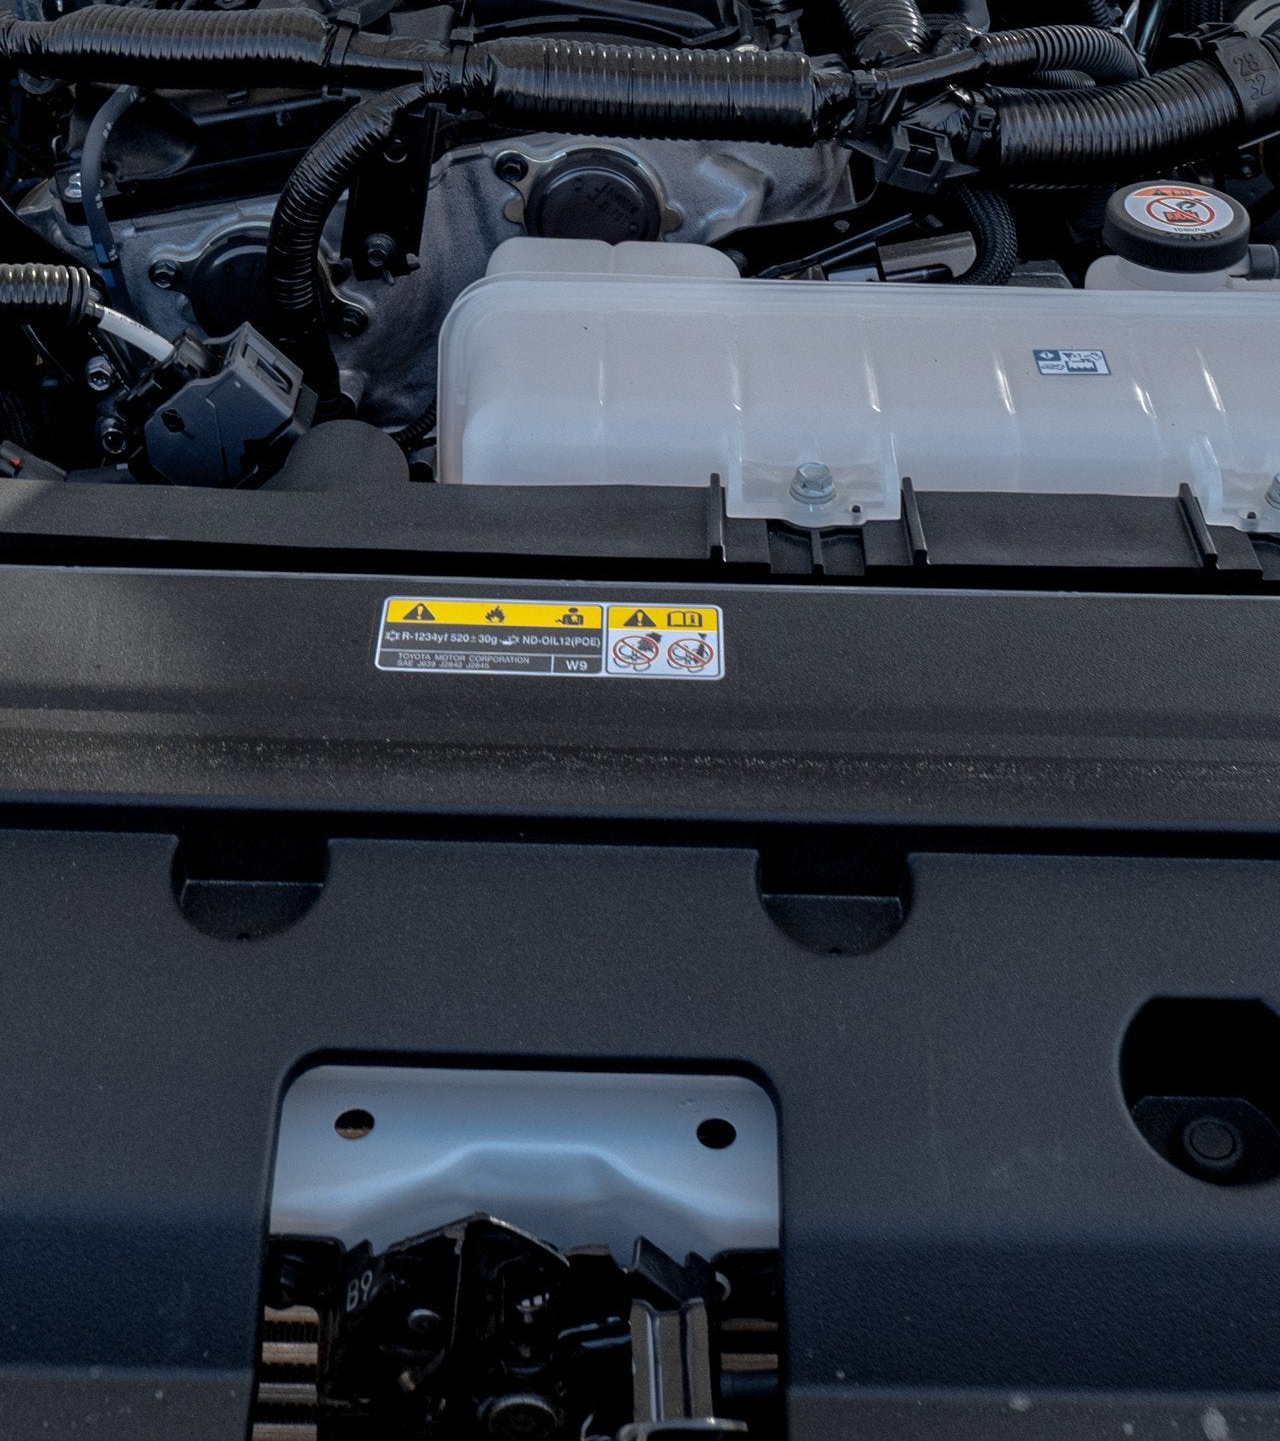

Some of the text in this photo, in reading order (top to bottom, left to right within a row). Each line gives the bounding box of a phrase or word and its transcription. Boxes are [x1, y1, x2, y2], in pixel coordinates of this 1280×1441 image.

[401, 630, 448, 644] R-1234yf
[522, 635, 601, 648] ND-OIL12(POE)
[398, 652, 530, 664] TOYOTA MOTOR CORPORATION
[565, 659, 588, 671] W9
